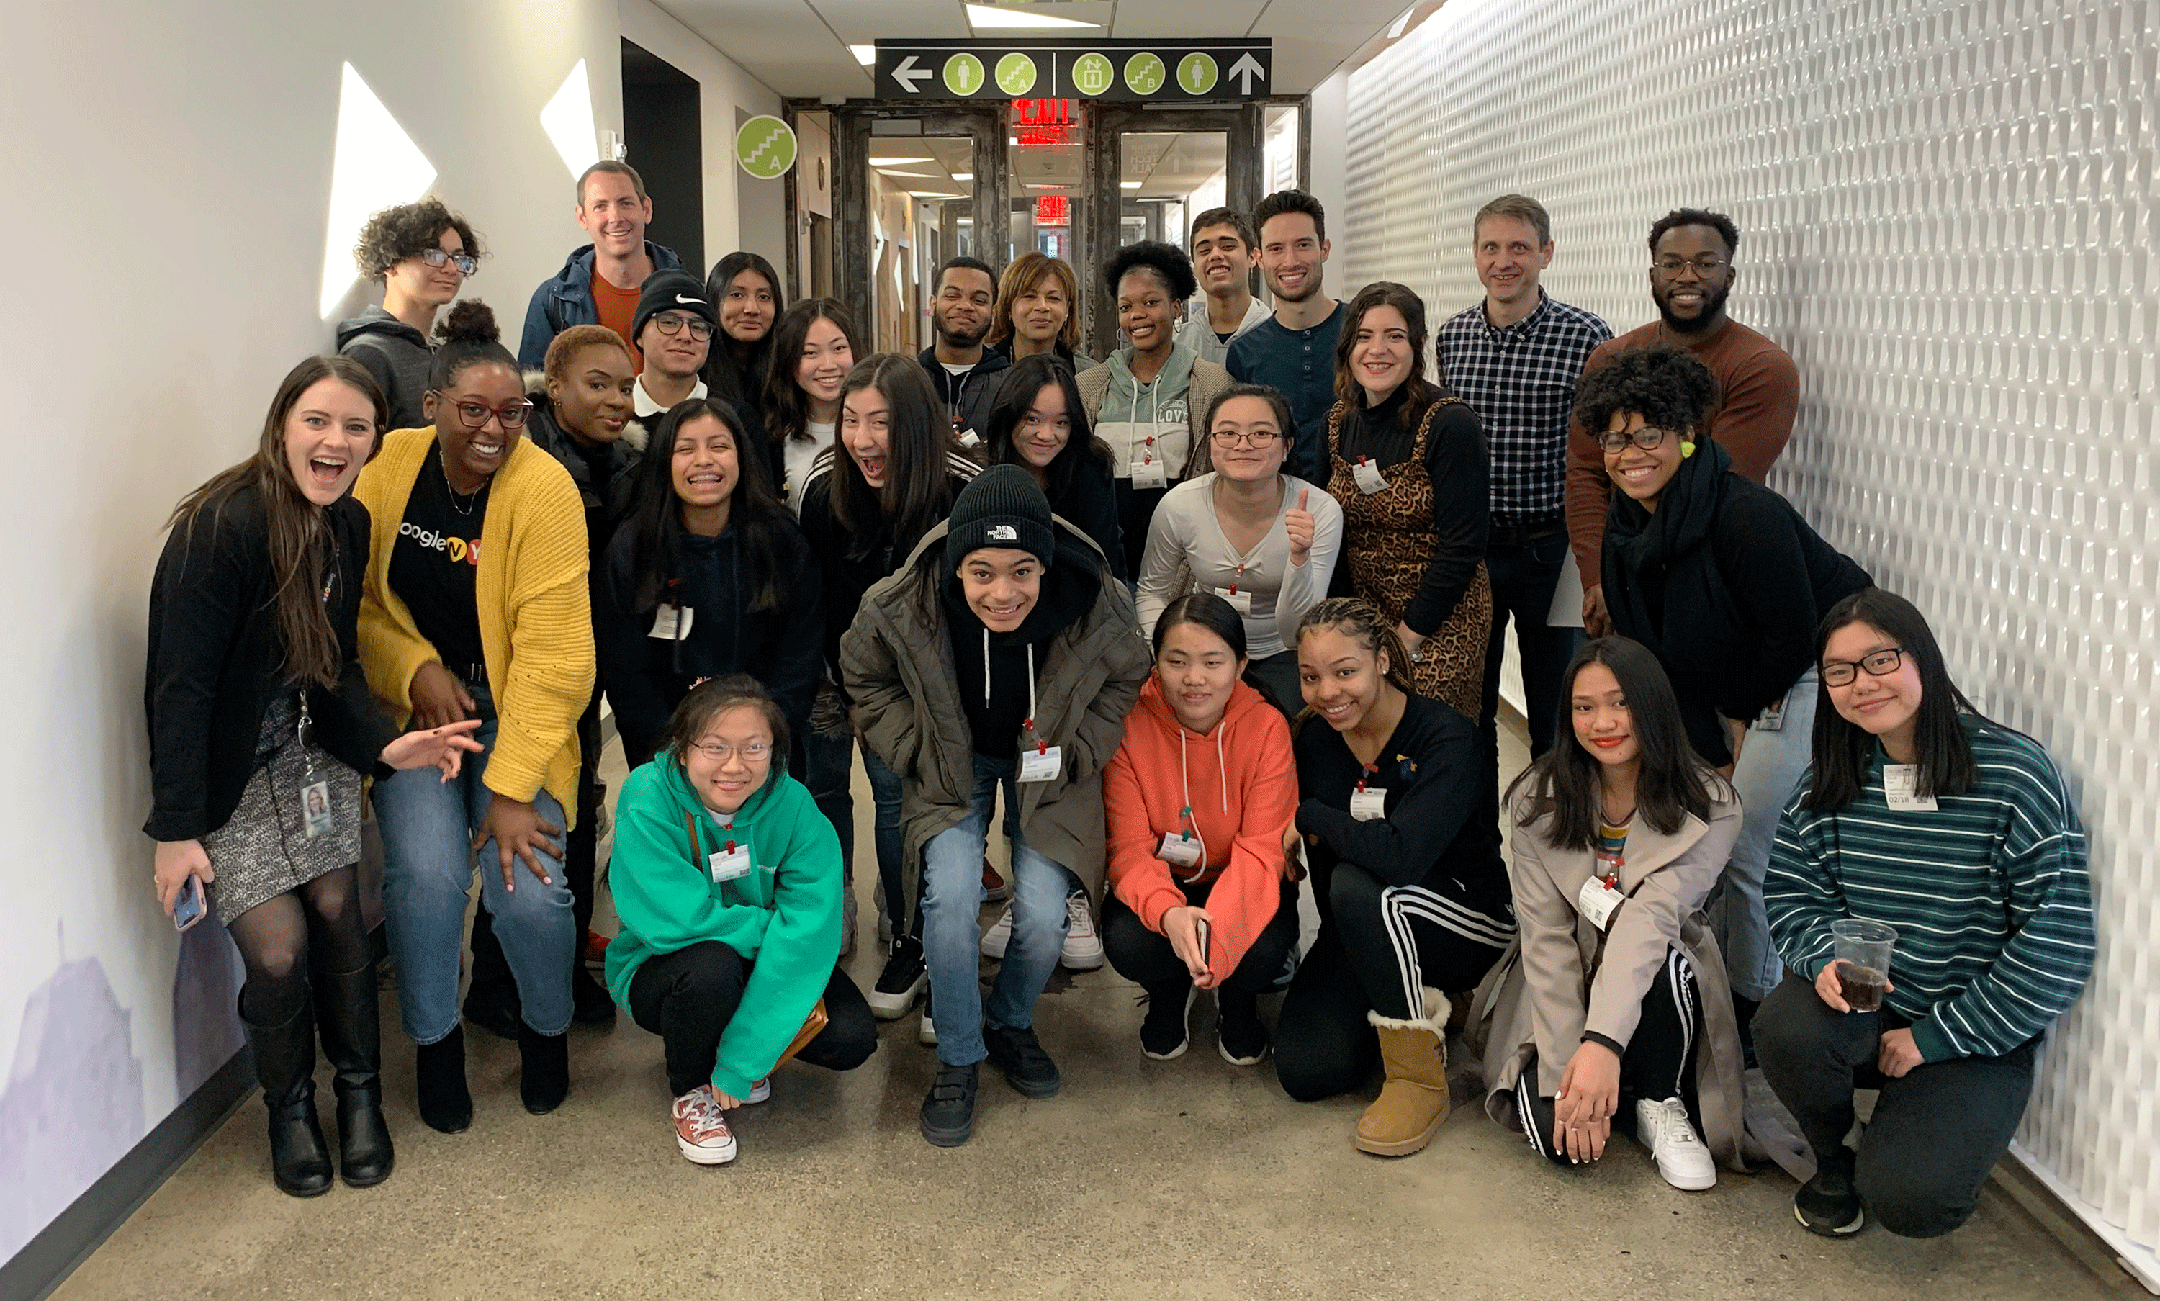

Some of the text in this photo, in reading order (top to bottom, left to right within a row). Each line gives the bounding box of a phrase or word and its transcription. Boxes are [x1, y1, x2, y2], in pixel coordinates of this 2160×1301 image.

[1018, 78, 1027, 89] A
[1147, 78, 1155, 88] B
[769, 154, 781, 170] A
